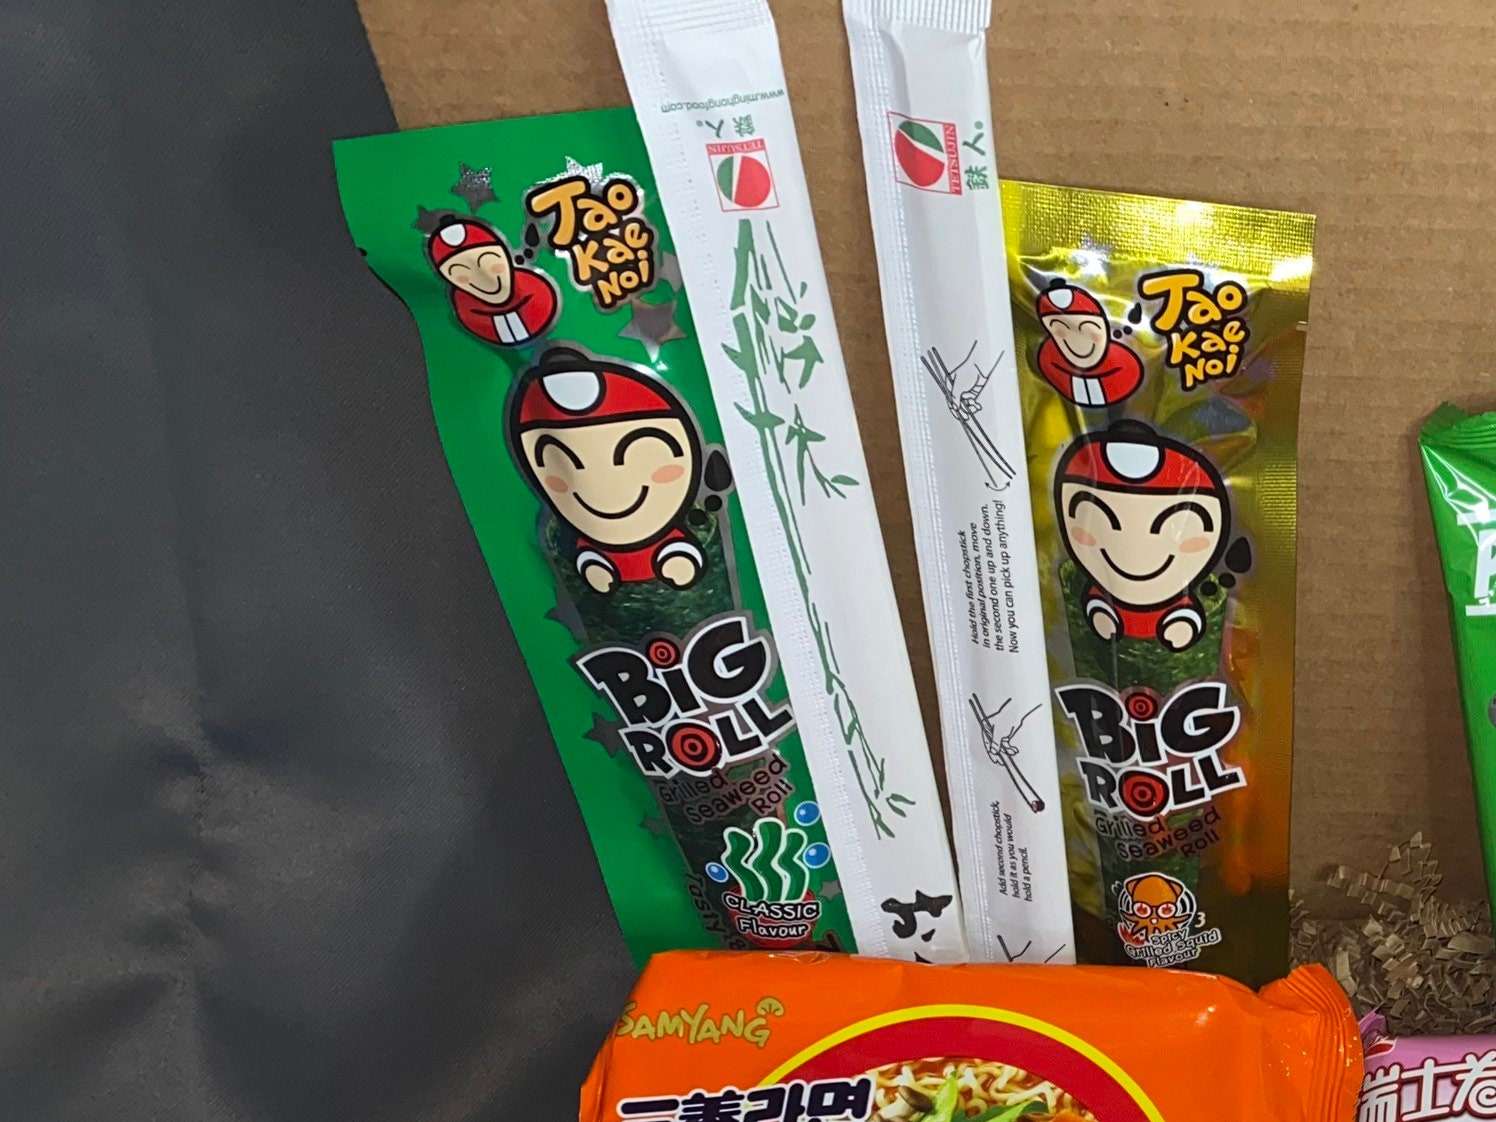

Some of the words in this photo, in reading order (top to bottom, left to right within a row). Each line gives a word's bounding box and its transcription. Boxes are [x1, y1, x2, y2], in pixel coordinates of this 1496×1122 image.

[707, 140, 764, 154] TETSUJIN
[943, 123, 963, 196] TETSUJIN
[530, 177, 636, 246] Tao
[573, 222, 648, 282] Kae
[1142, 273, 1243, 331] Tao
[1170, 320, 1245, 364] Kae
[1185, 345, 1239, 388] Noi
[970, 523, 979, 552] move
[992, 500, 1009, 549] anything!
[958, 531, 971, 579] chopstick
[964, 581, 974, 599] first
[999, 567, 1014, 588] pick
[967, 602, 976, 618] the
[1003, 591, 1015, 608] can
[976, 599, 990, 637] original
[989, 598, 1001, 633] second
[1006, 610, 1019, 629] you
[970, 620, 979, 644] Hold
[1008, 631, 1019, 653] Now
[619, 699, 796, 778] ROLL
[659, 770, 728, 803] Grilled
[751, 780, 793, 815] Roll
[1078, 753, 1246, 820] ROLL
[1003, 813, 1014, 842] would
[1096, 816, 1164, 837] Grilled
[1182, 829, 1220, 857] Roll
[994, 845, 1006, 877] second
[996, 877, 1008, 895] Add
[1009, 879, 1021, 898] hold
[1021, 882, 1033, 902] hold
[738, 918, 808, 938] Flavour
[1151, 930, 1188, 945] Spicy
[1126, 943, 1174, 959] Grilled
[1177, 931, 1219, 950] Squid
[1148, 950, 1198, 966] Flavour
[617, 1001, 769, 1047] SAMYANG
